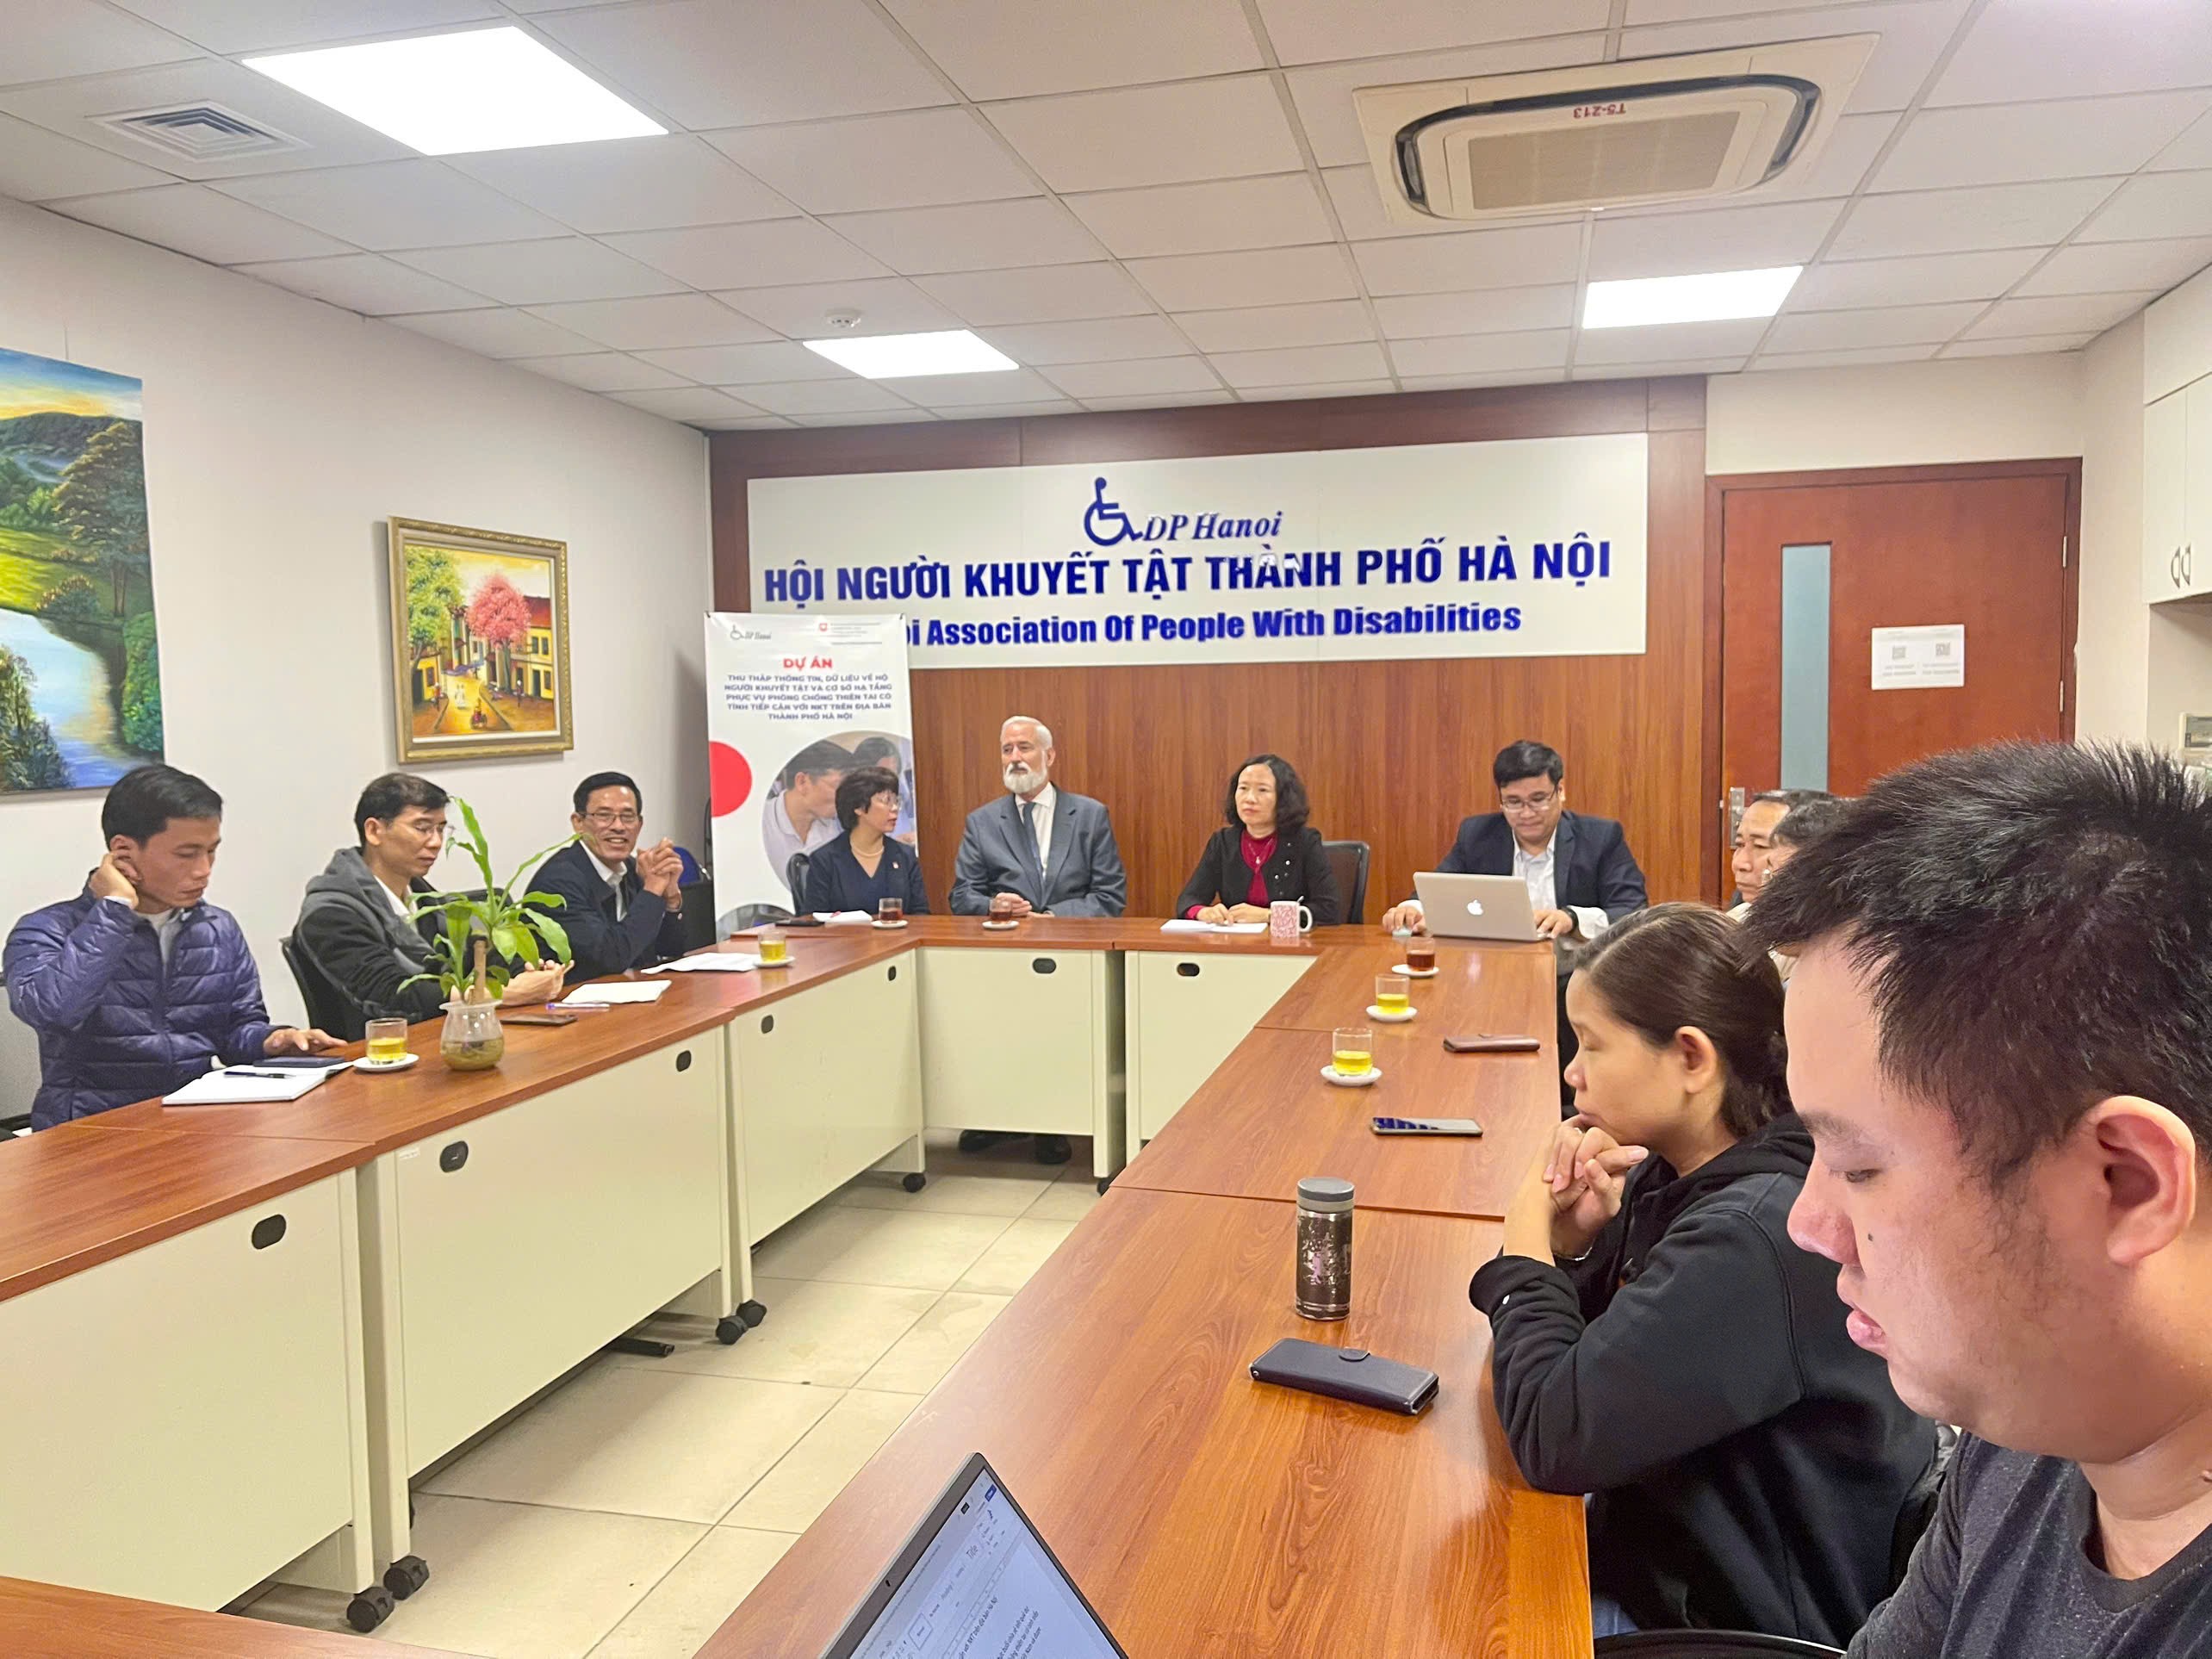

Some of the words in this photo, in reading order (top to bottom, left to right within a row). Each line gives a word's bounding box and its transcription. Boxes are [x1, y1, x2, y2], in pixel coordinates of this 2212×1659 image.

[1142, 514, 1188, 541] DP
[1191, 511, 1283, 539] Hanoi
[764, 560, 824, 608] HỘI
[837, 555, 951, 600] NGƯỜI
[964, 551, 1110, 597] KHUYẾT
[1122, 548, 1192, 600] TẬT
[1205, 544, 1341, 590] THÀNH
[1358, 536, 1447, 586] PHỐ
[1458, 535, 1518, 582] HÀ
[1532, 531, 1611, 587] NỘI
[927, 616, 1097, 646] Association
[1104, 615, 1135, 642] Of
[1142, 611, 1245, 643] People
[1252, 607, 1326, 638] With
[1333, 602, 1522, 636] Disabilities
[783, 656, 806, 671] DỰ
[811, 656, 833, 668] ÁN
